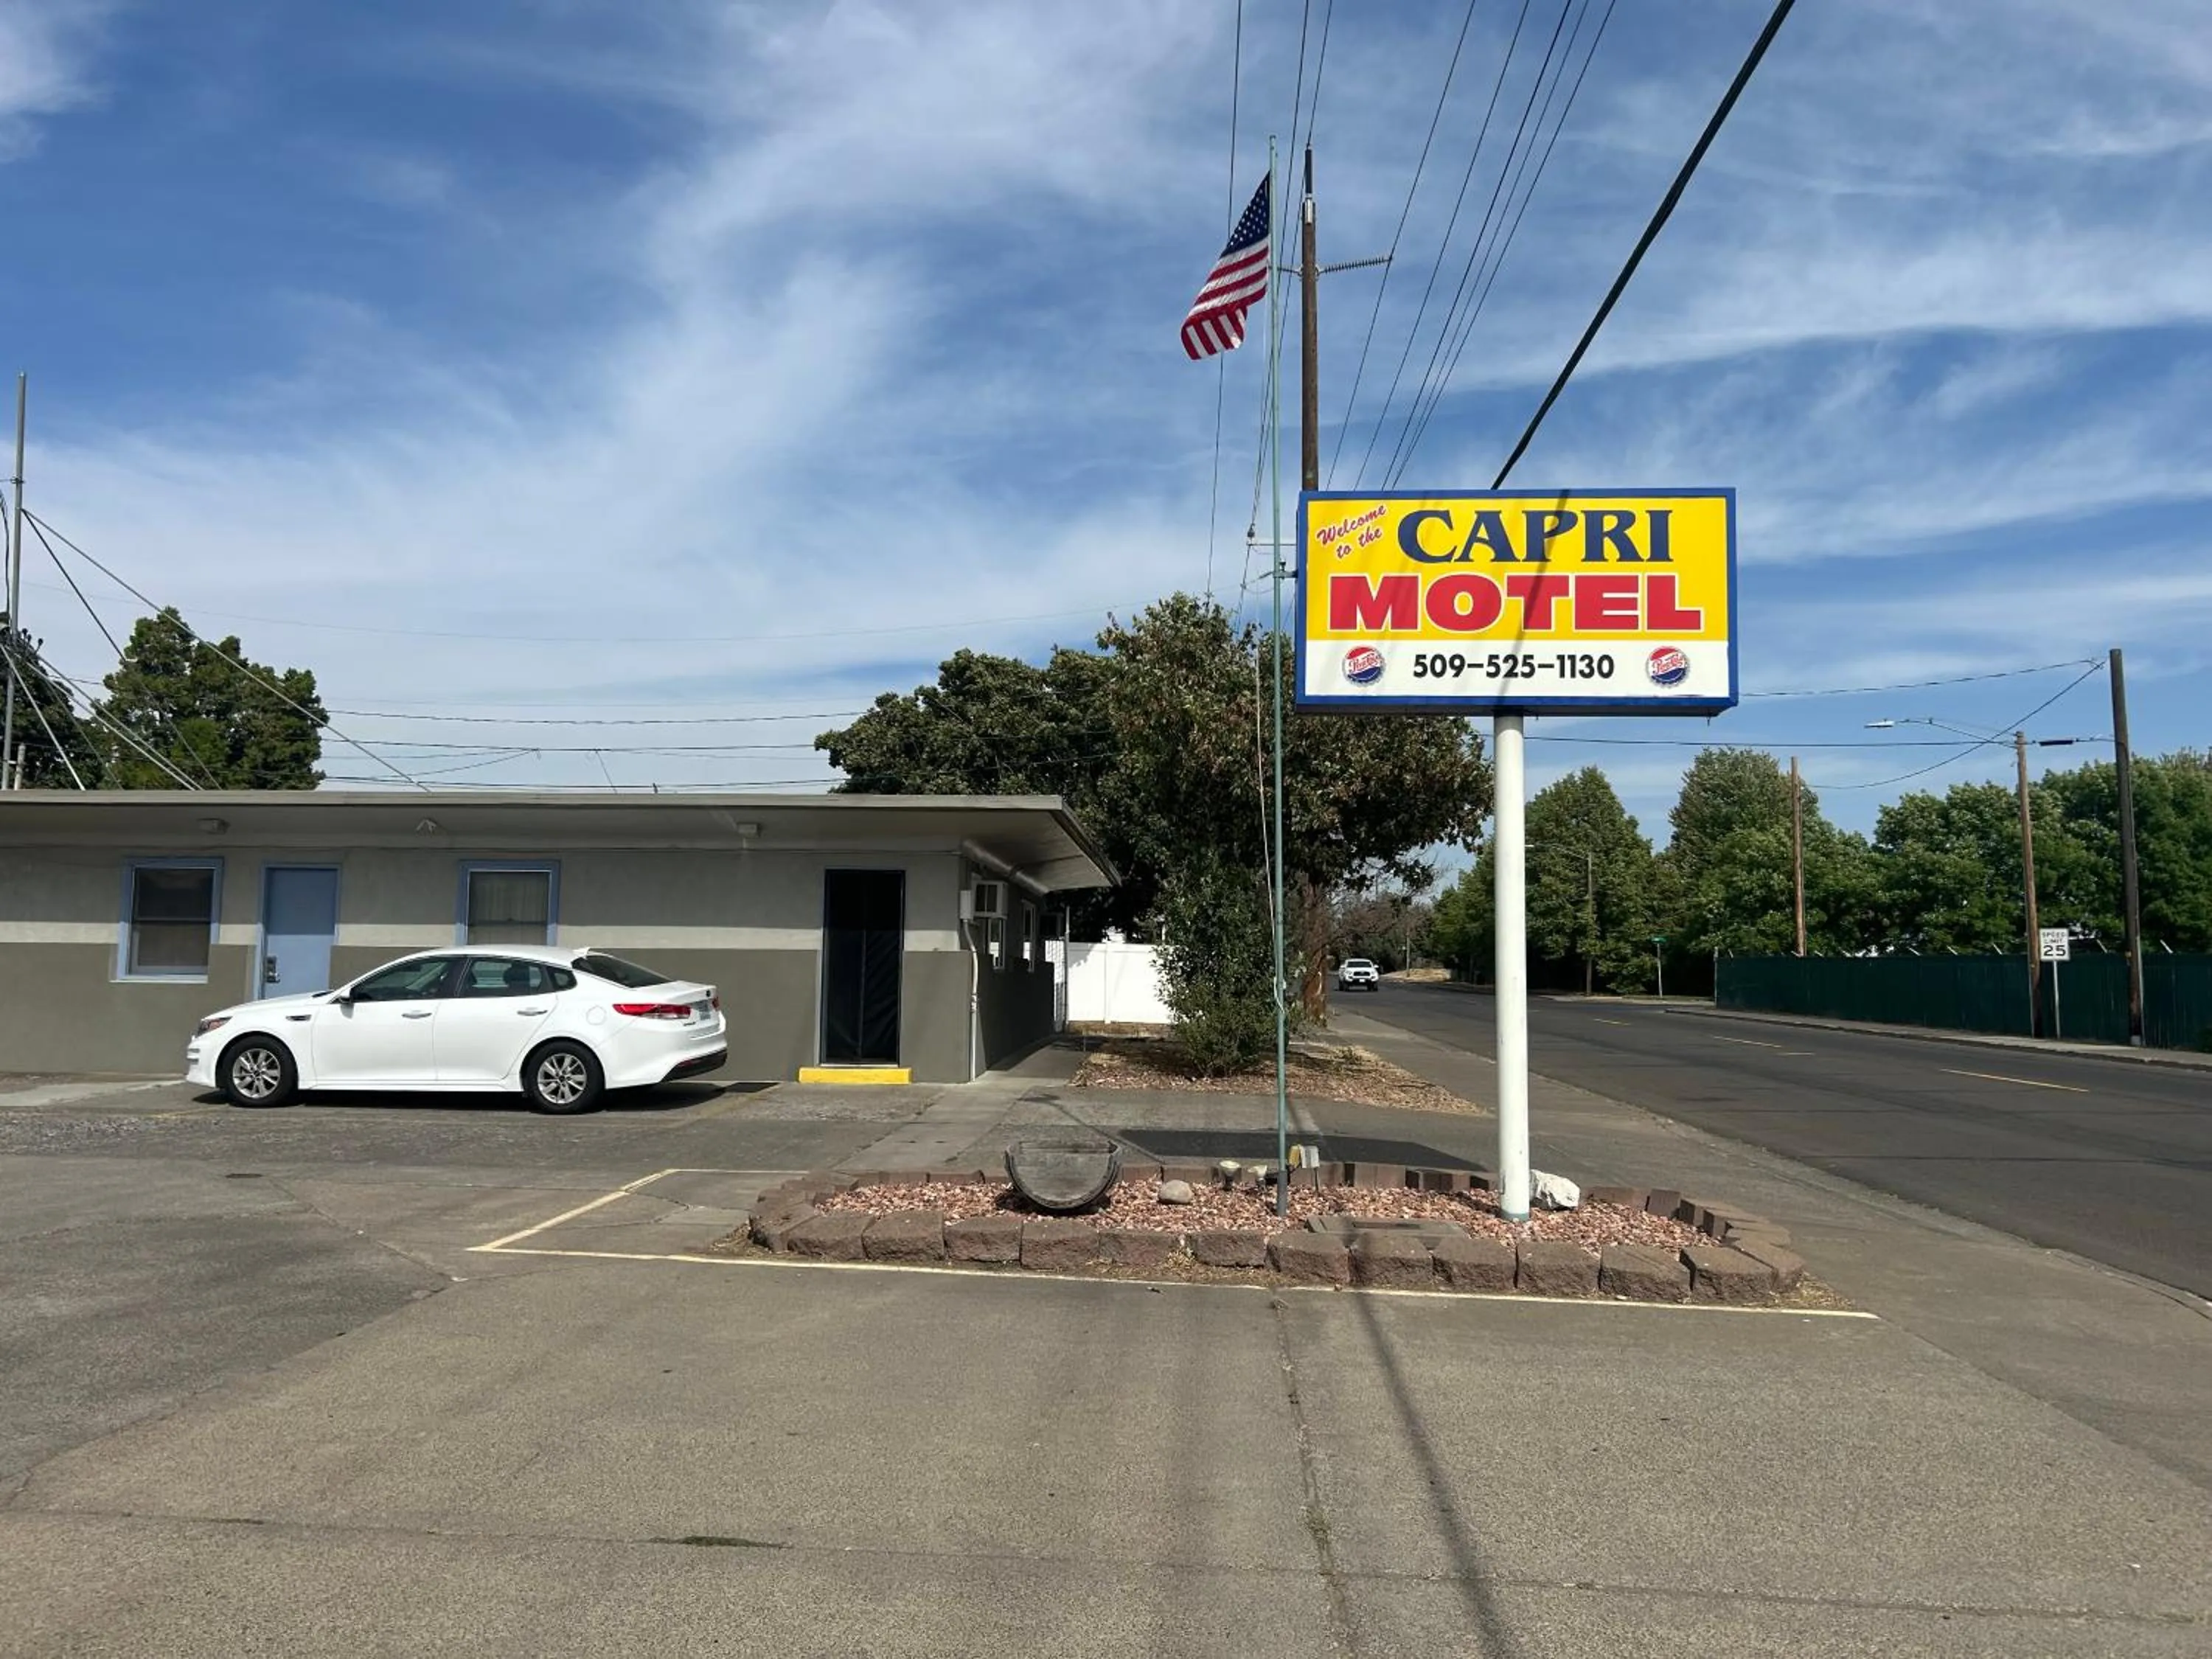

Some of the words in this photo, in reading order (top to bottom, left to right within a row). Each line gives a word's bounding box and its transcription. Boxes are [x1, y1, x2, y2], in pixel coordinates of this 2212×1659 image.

[1316, 505, 1386, 545] Welcome
[1336, 545, 1352, 558] to
[1358, 526, 1382, 547] the
[1398, 509, 1674, 563] CAPRI
[1329, 574, 1703, 631] MOTEL
[1413, 653, 1615, 678] 509-525-1130
[2043, 945, 2066, 956] 25
